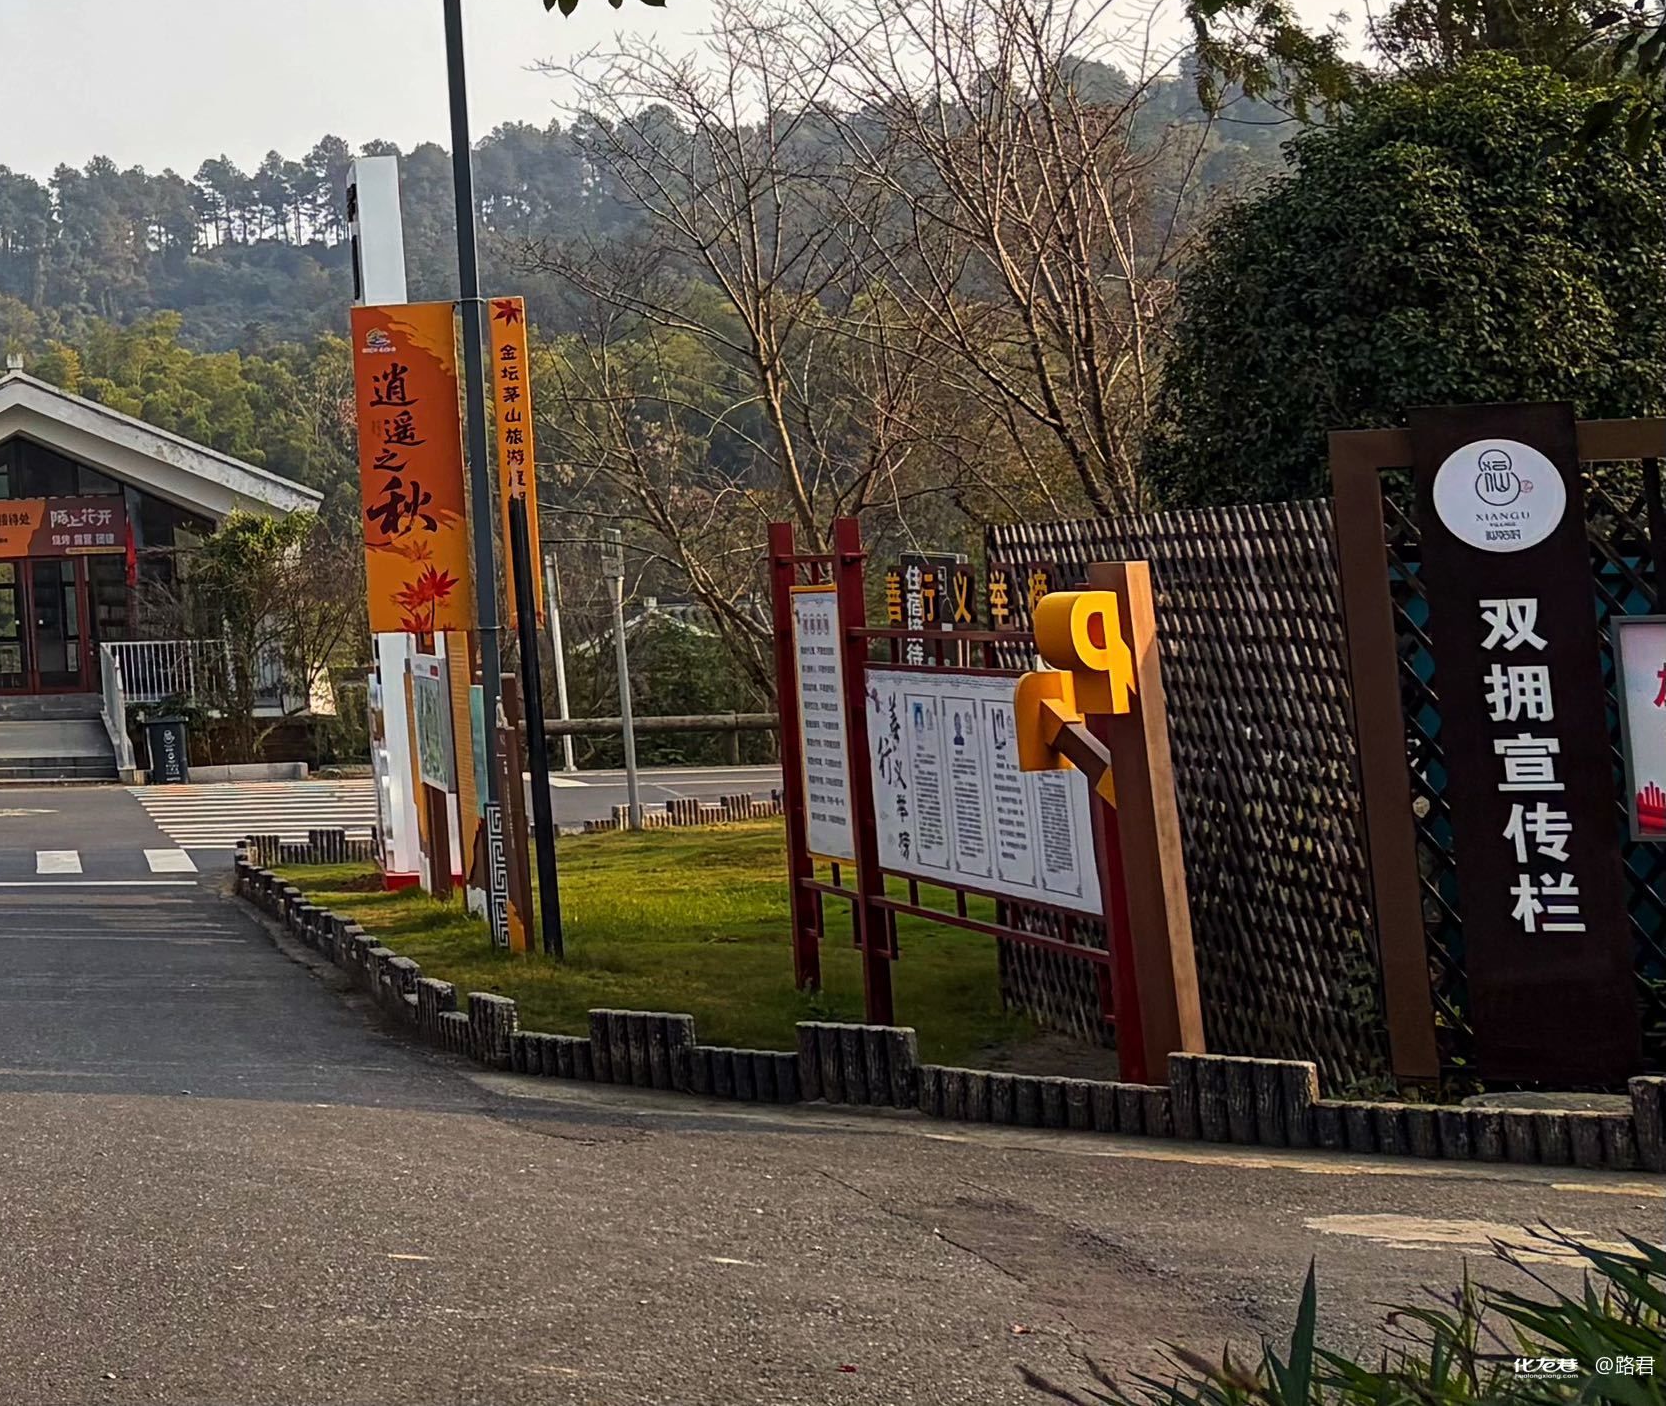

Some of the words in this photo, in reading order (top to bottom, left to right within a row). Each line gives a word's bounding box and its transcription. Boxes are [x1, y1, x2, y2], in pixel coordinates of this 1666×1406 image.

[366, 362, 438, 537] 逍遥之秋
[50, 508, 112, 529] 陌上花开
[1475, 511, 1530, 522] XIANGU
[1478, 597, 1586, 933] 双拥宣传栏
